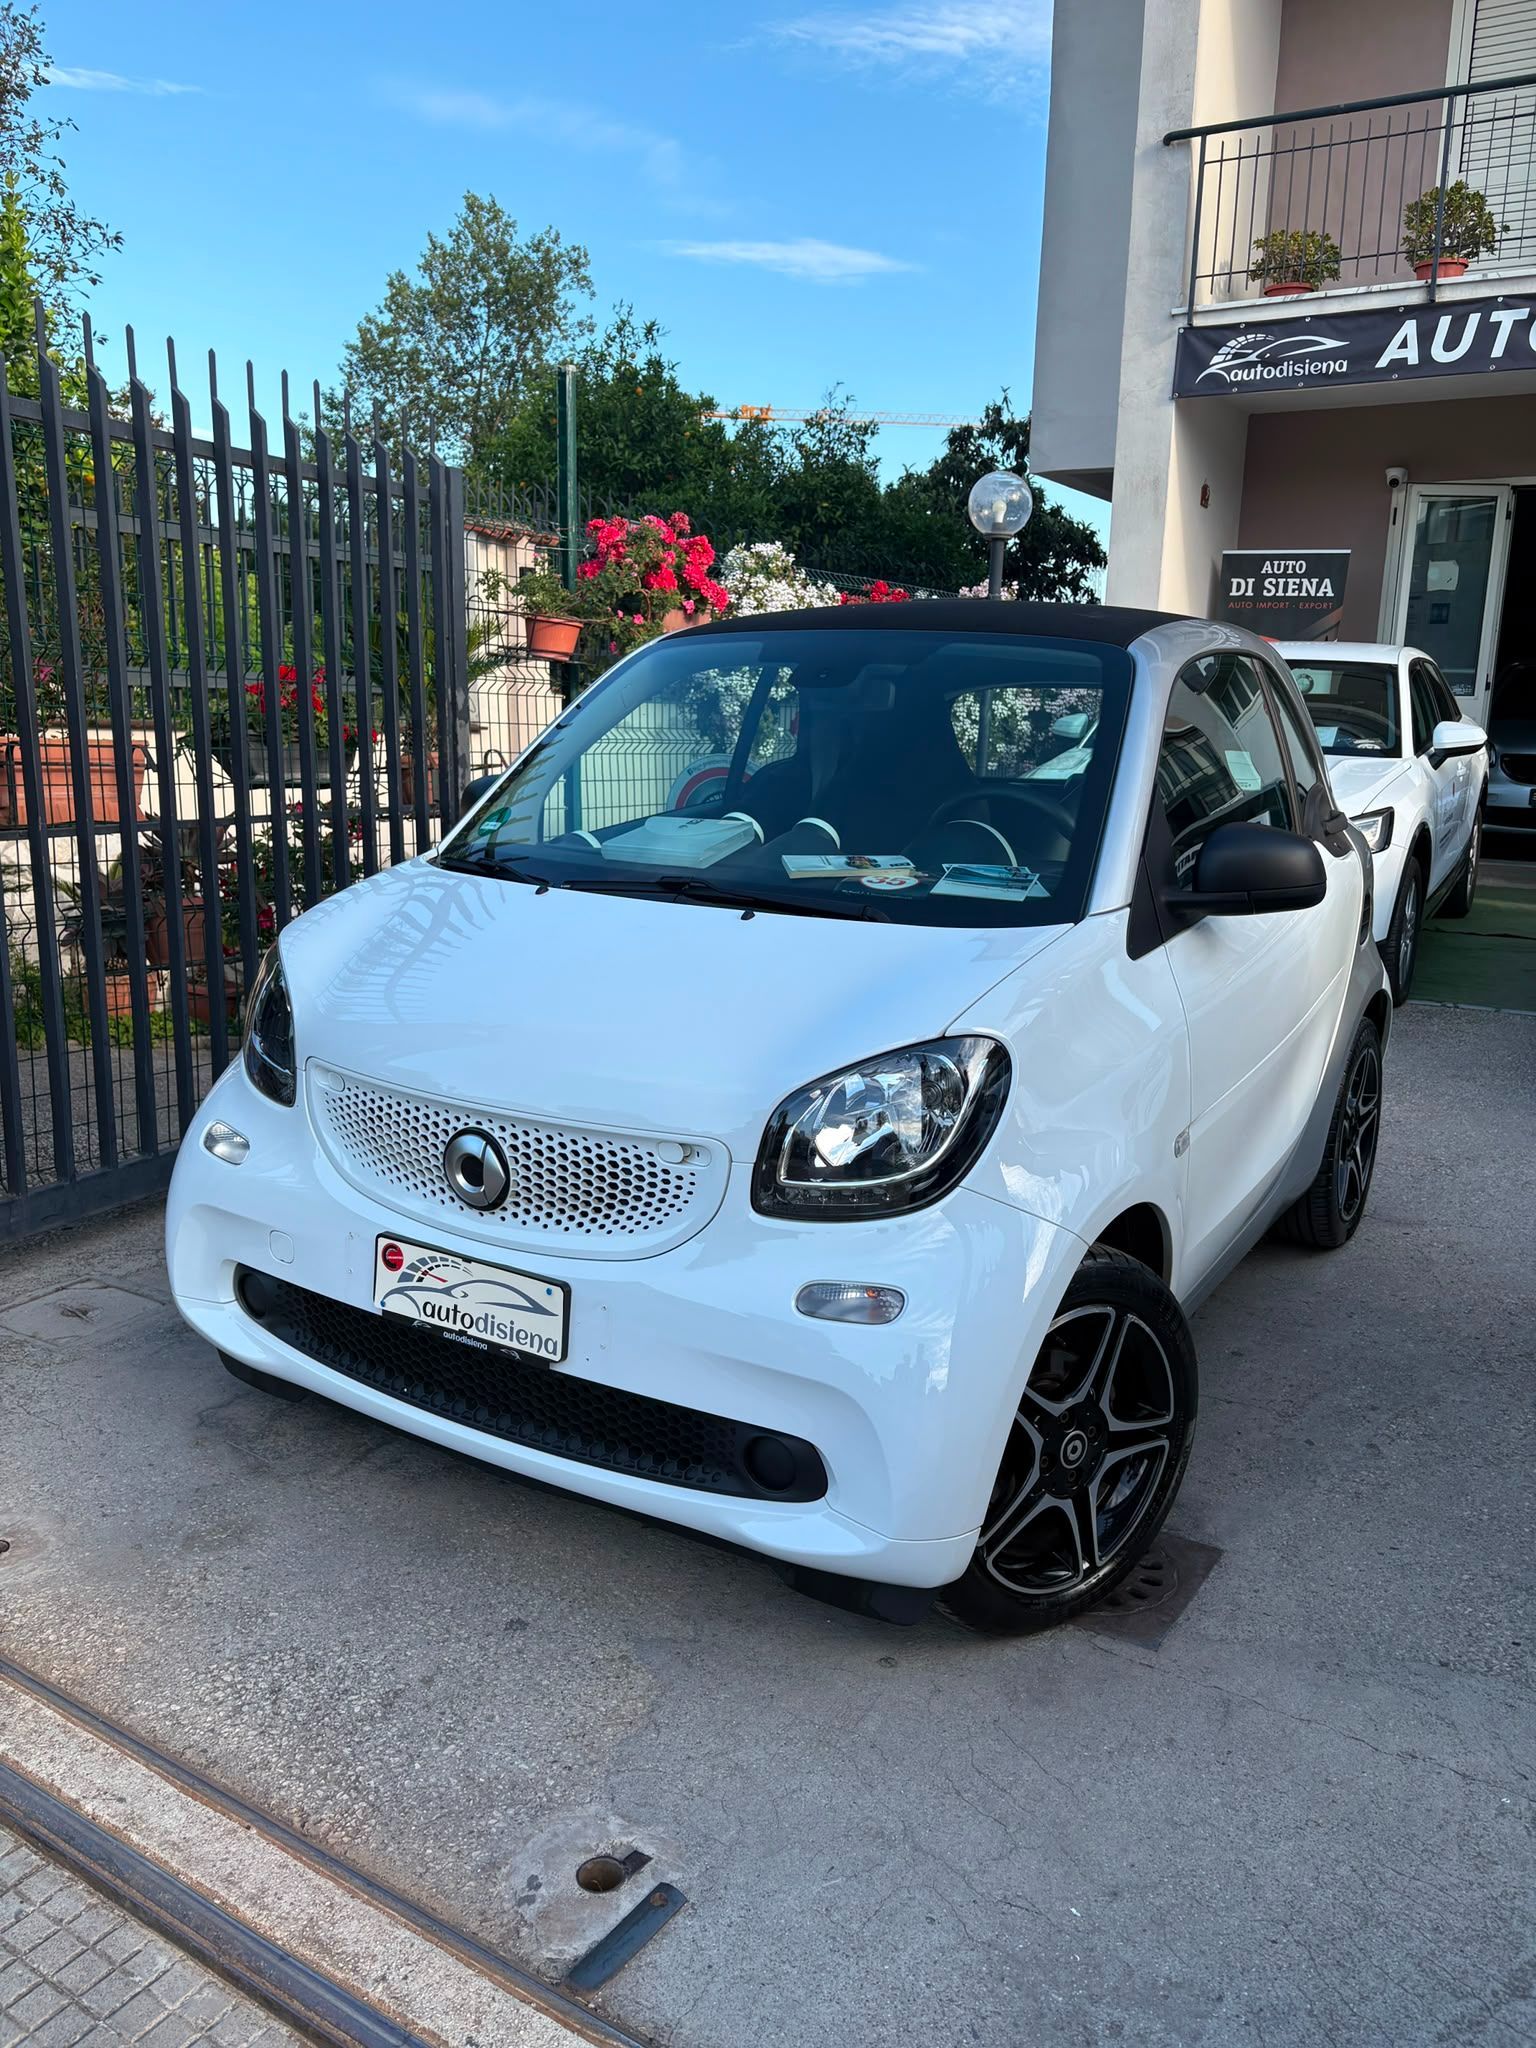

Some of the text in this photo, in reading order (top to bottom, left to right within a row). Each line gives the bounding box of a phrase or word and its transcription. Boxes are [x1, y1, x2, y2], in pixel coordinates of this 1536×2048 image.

[1375, 308, 1536, 369] AUT
[1229, 359, 1348, 381] autodisiena
[1261, 560, 1306, 574] AUTO
[1229, 578, 1334, 597] DI SIENA
[1228, 601, 1253, 609] AUTO
[1256, 601, 1289, 609] IMPORT
[422, 1301, 558, 1356] autodisiena
[443, 1330, 488, 1351] autodisiena
